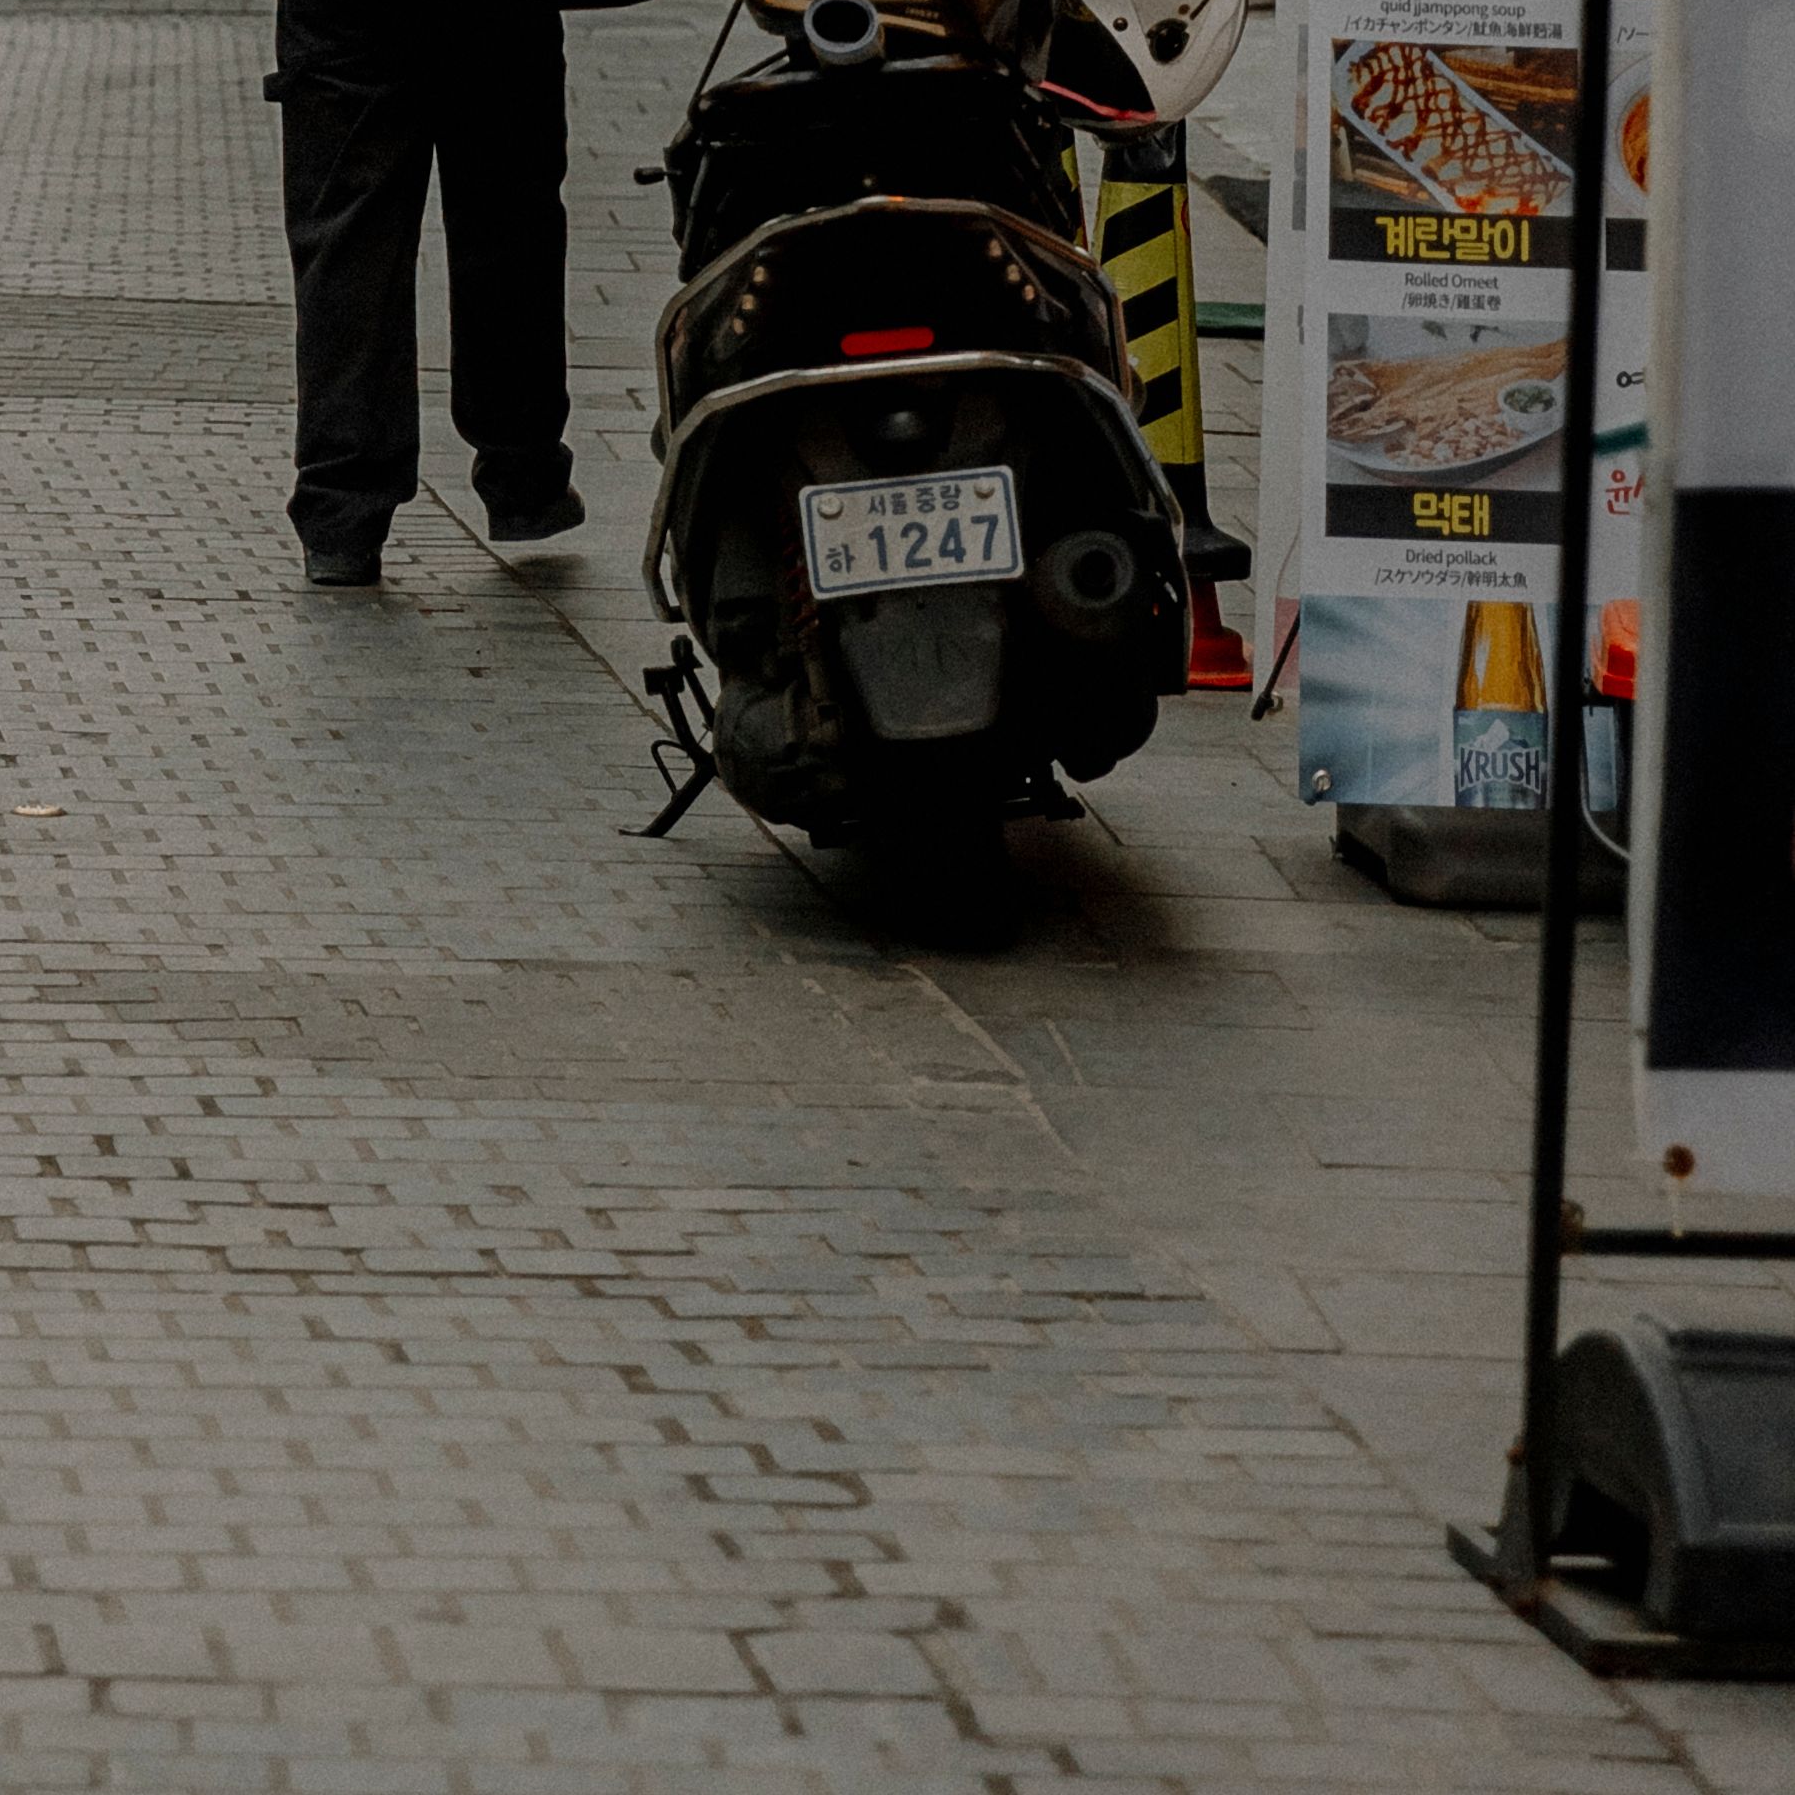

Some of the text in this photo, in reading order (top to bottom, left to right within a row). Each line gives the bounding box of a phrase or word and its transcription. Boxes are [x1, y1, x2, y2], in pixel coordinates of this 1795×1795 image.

[1412, 0, 1489, 19] jjamppong
[1491, 2, 1526, 19] soup
[1374, 215, 1531, 263] 계란말이
[1404, 271, 1449, 289] Rolled
[867, 483, 962, 517] 서울 중랑
[1413, 491, 1491, 537] 먹태
[825, 513, 999, 574] 하 1247
[1405, 548, 1499, 568] Dried pollack
[1459, 746, 1540, 795] KRUSH
